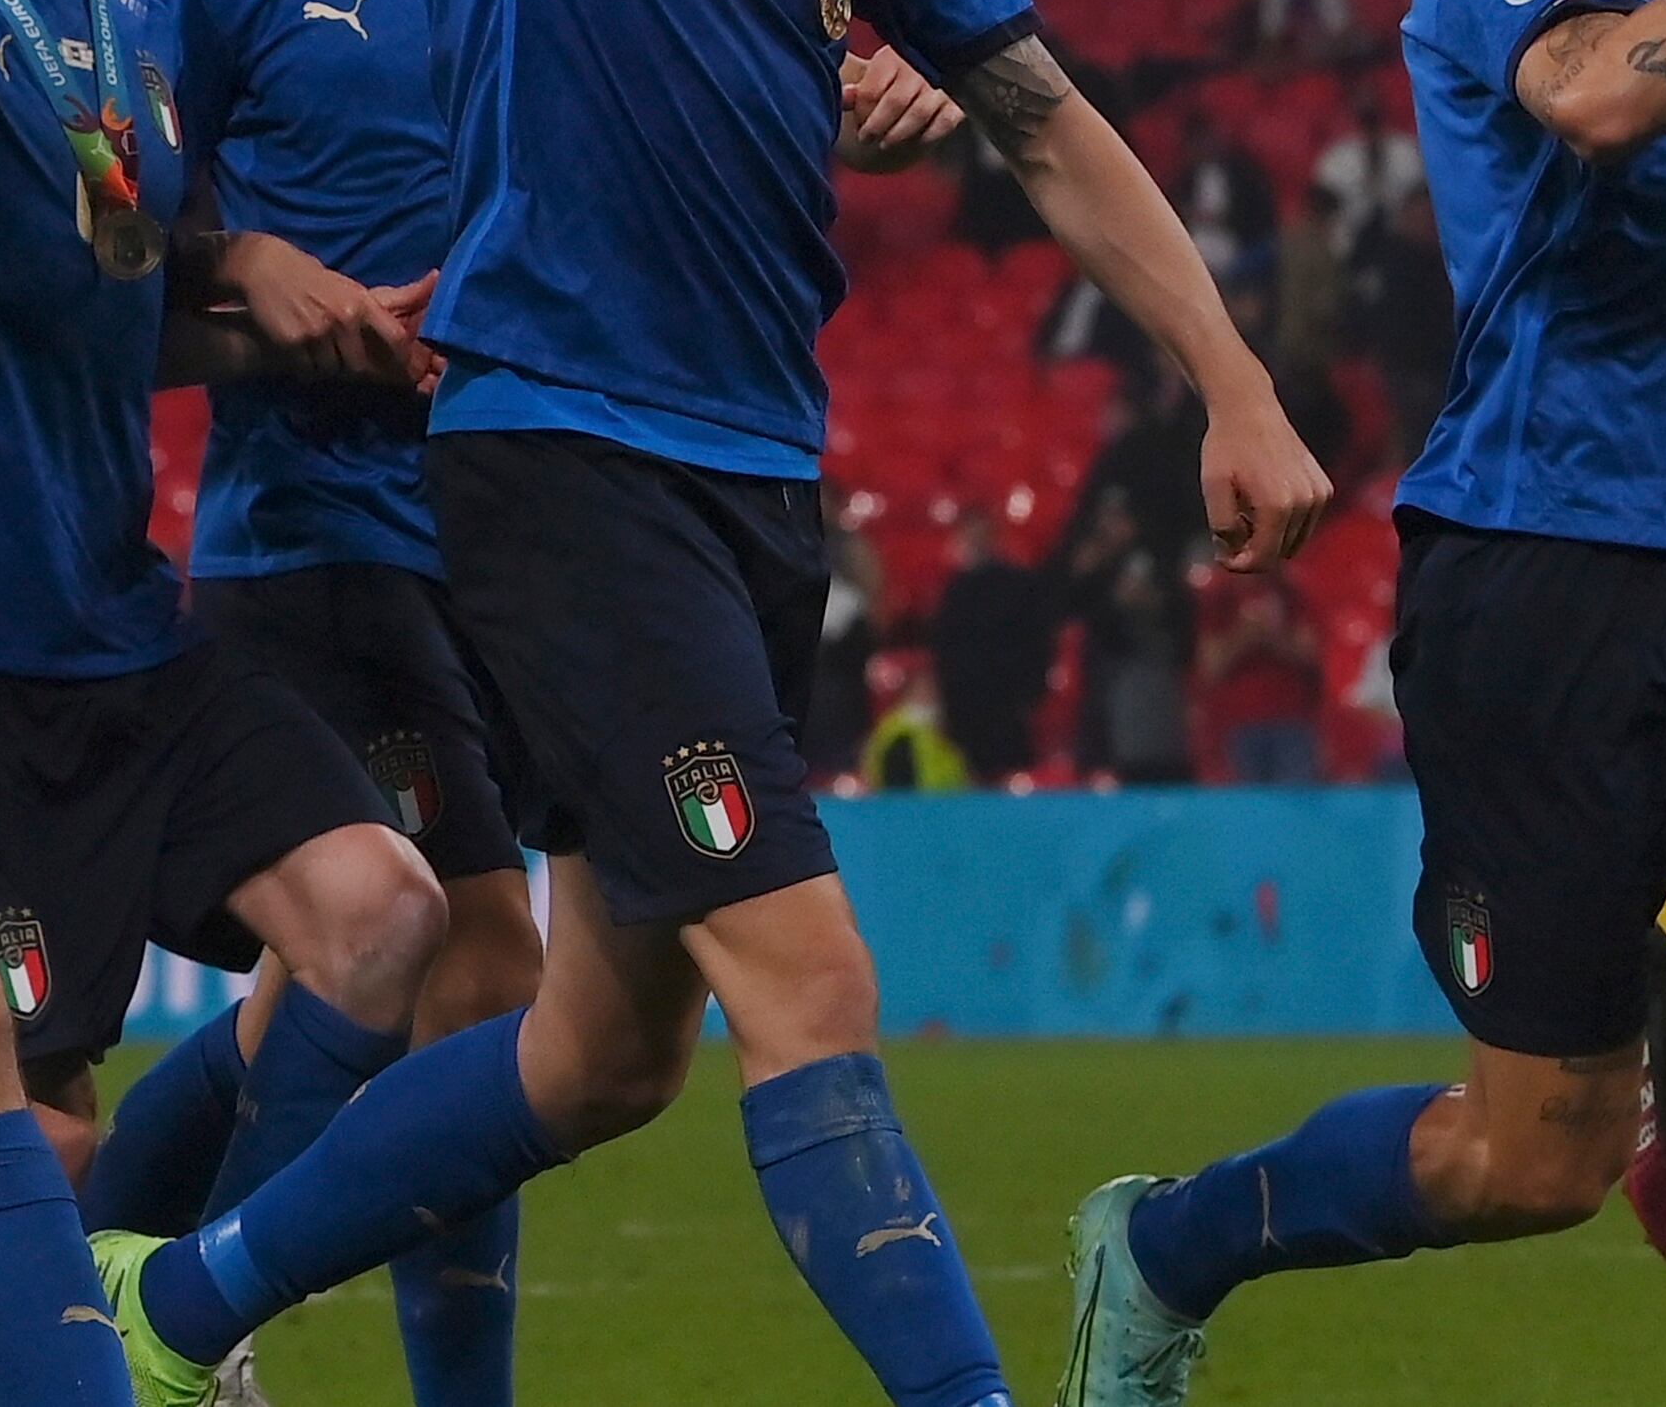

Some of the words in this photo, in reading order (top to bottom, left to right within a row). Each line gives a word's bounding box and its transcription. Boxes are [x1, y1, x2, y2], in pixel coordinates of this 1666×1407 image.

[33, 40, 66, 86] UEFA
[101, 41, 119, 86] 2020
[673, 761, 732, 793] ITALIA
